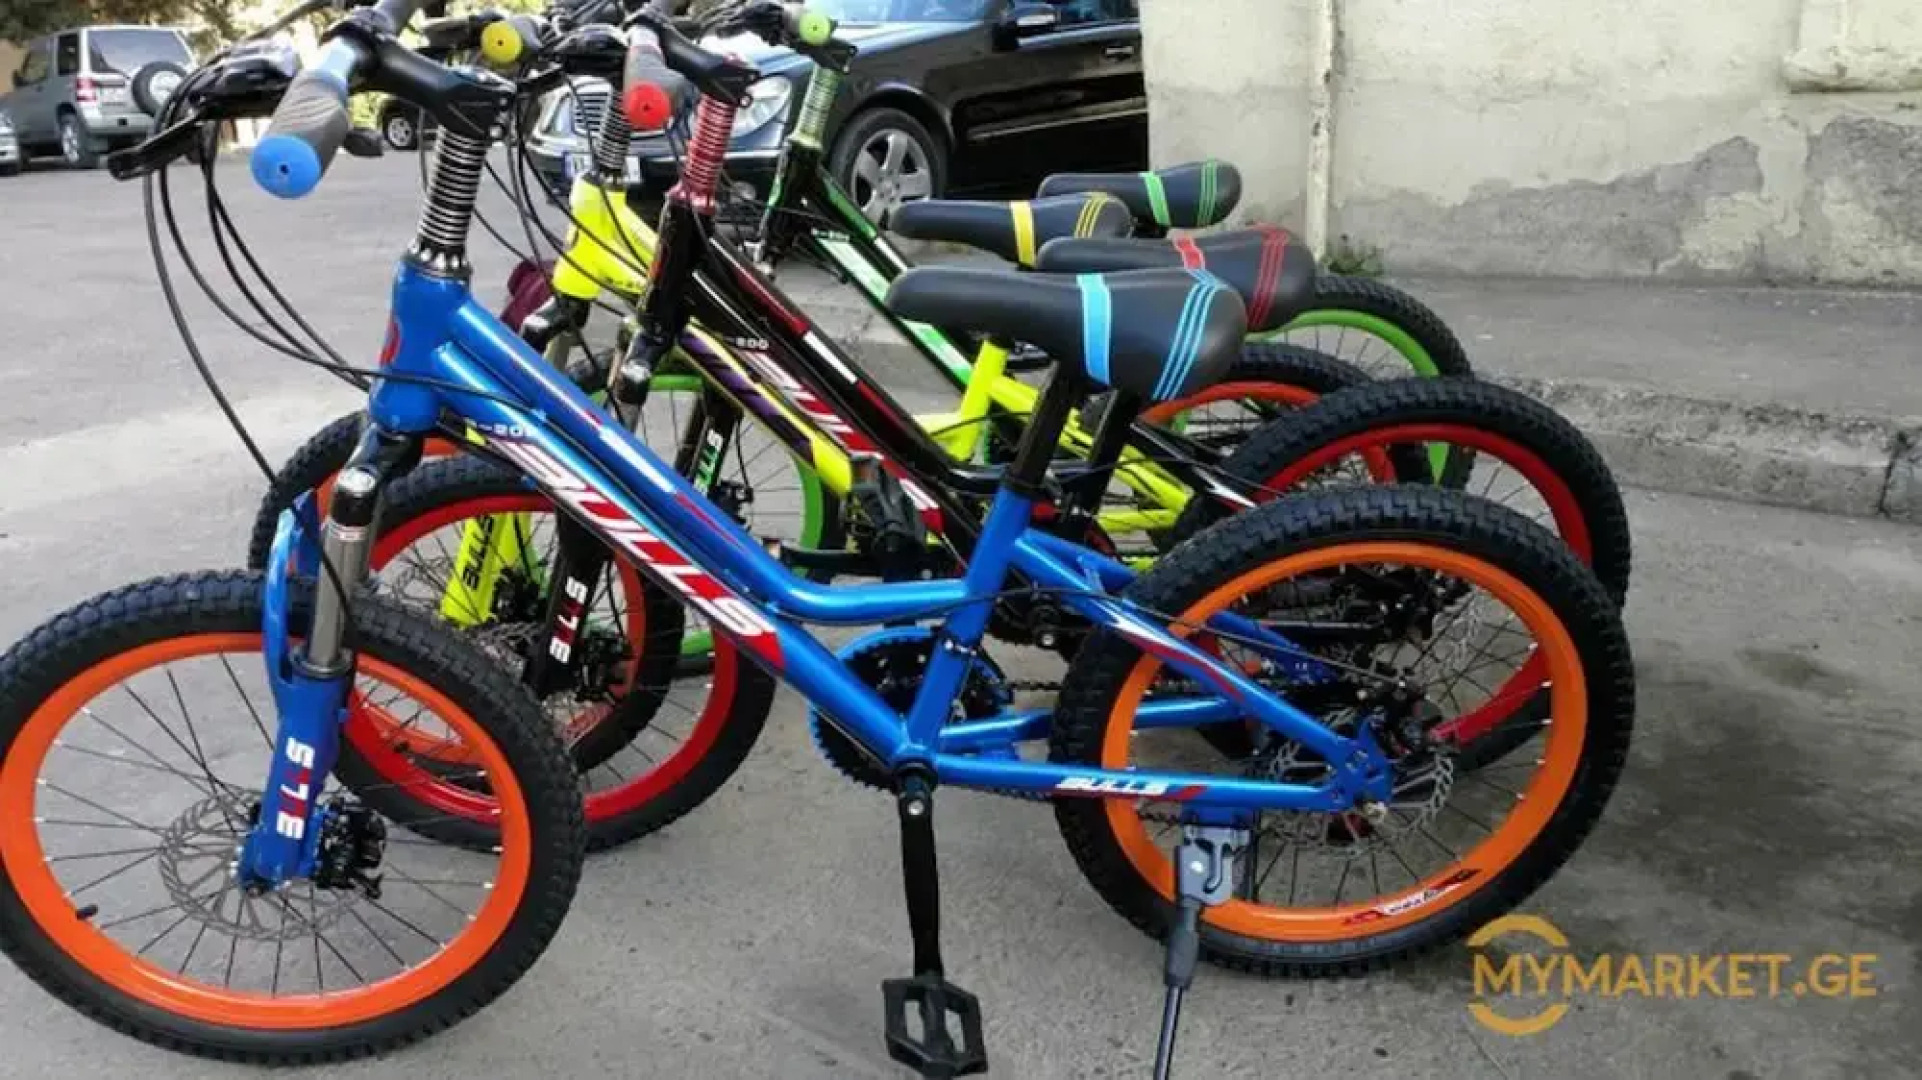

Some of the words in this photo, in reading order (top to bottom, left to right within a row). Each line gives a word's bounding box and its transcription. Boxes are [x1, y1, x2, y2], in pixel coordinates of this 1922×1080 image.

[486, 437, 777, 637] BULLS
[276, 736, 316, 839] BULLS
[1055, 776, 1170, 796] BULLS
